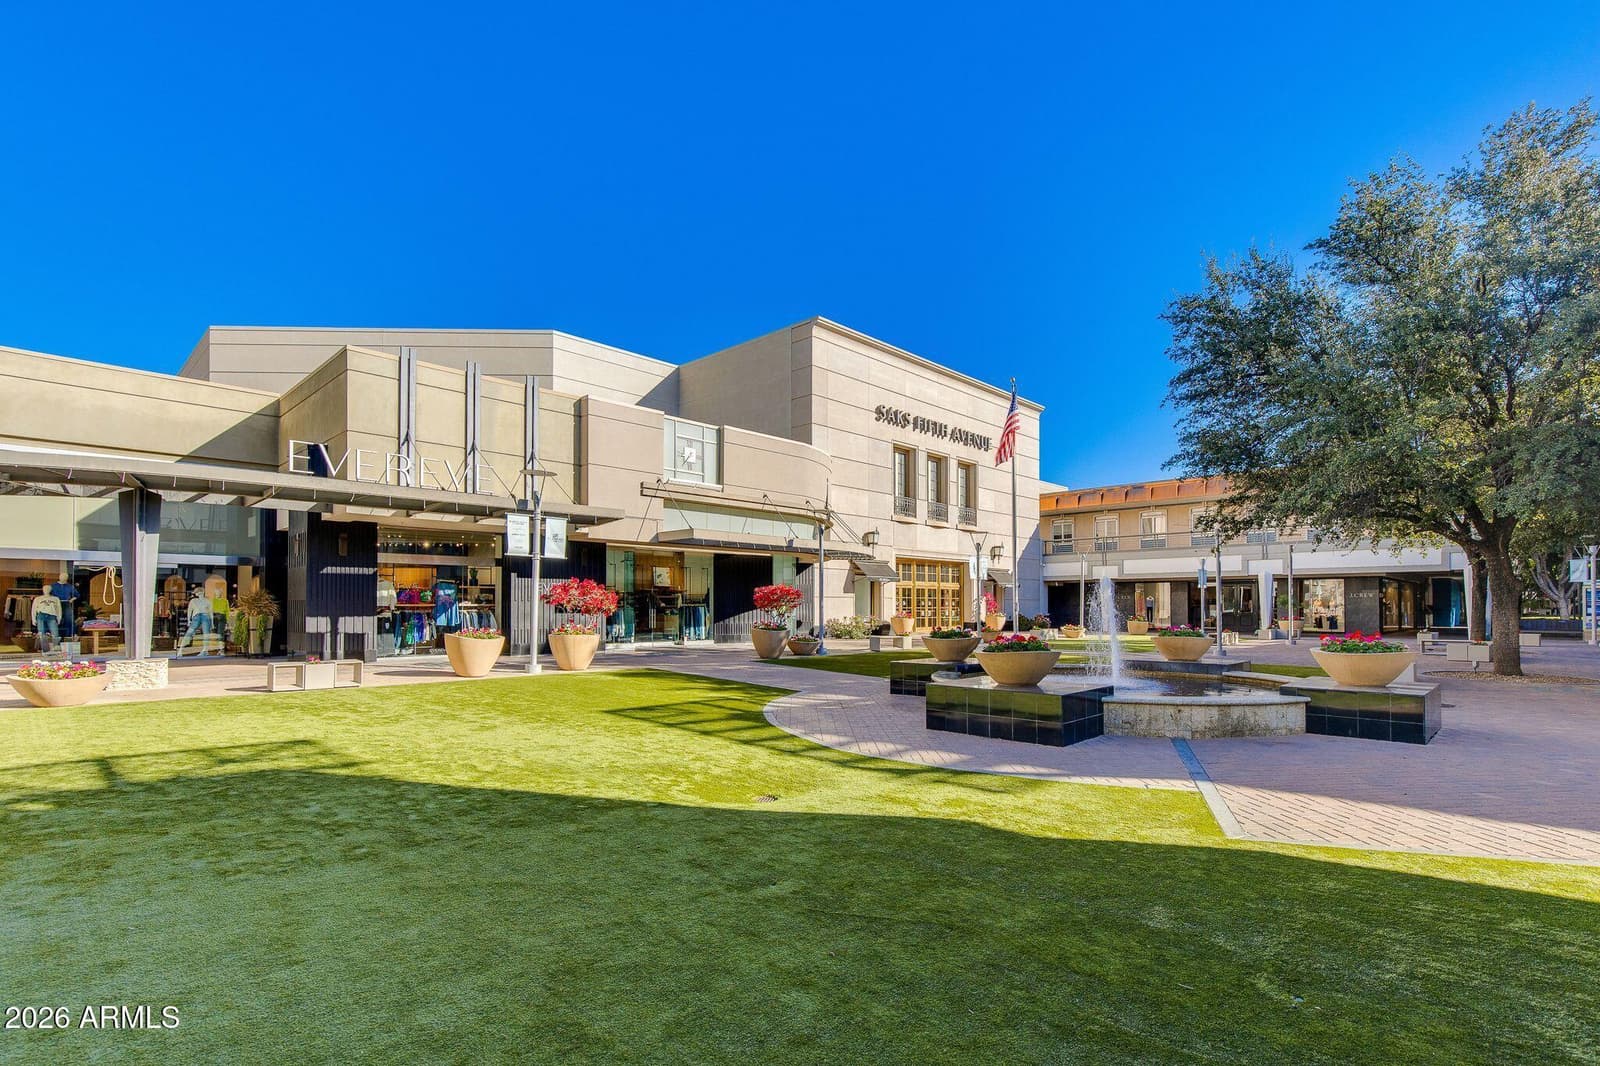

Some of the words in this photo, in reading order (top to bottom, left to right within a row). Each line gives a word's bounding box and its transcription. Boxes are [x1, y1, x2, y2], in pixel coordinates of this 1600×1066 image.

[875, 404, 911, 429] SAKS
[912, 415, 948, 439] FIFTH
[949, 426, 992, 452] AVENUE
[289, 440, 494, 495] EVEREVE
